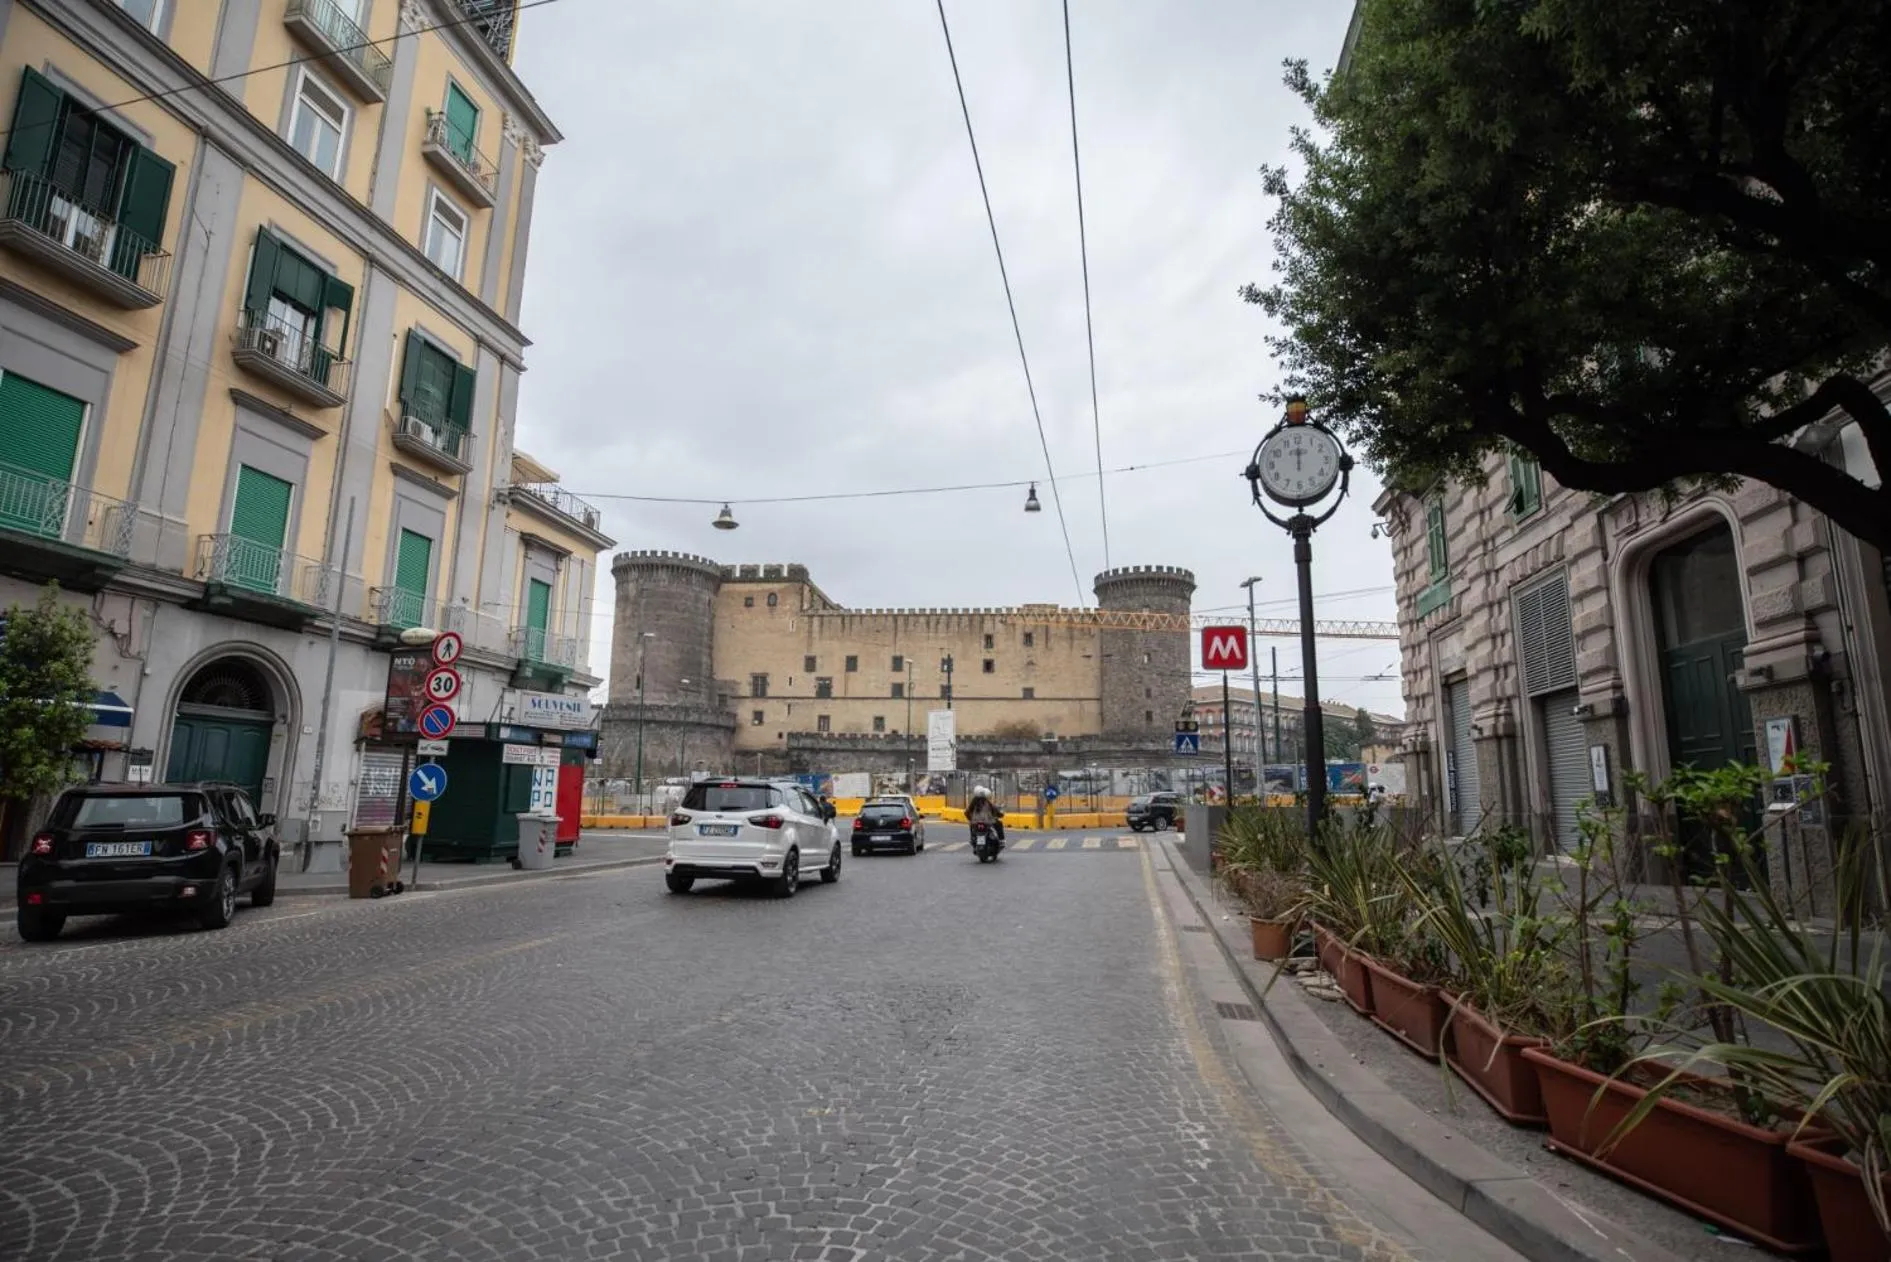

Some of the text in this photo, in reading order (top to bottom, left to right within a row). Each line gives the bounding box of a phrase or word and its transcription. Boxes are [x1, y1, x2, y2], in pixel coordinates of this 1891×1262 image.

[1294, 435, 1302, 445] 12
[1272, 449, 1282, 458] 10
[1208, 635, 1242, 660] M
[432, 676, 453, 692] 30
[96, 843, 108, 855] FN
